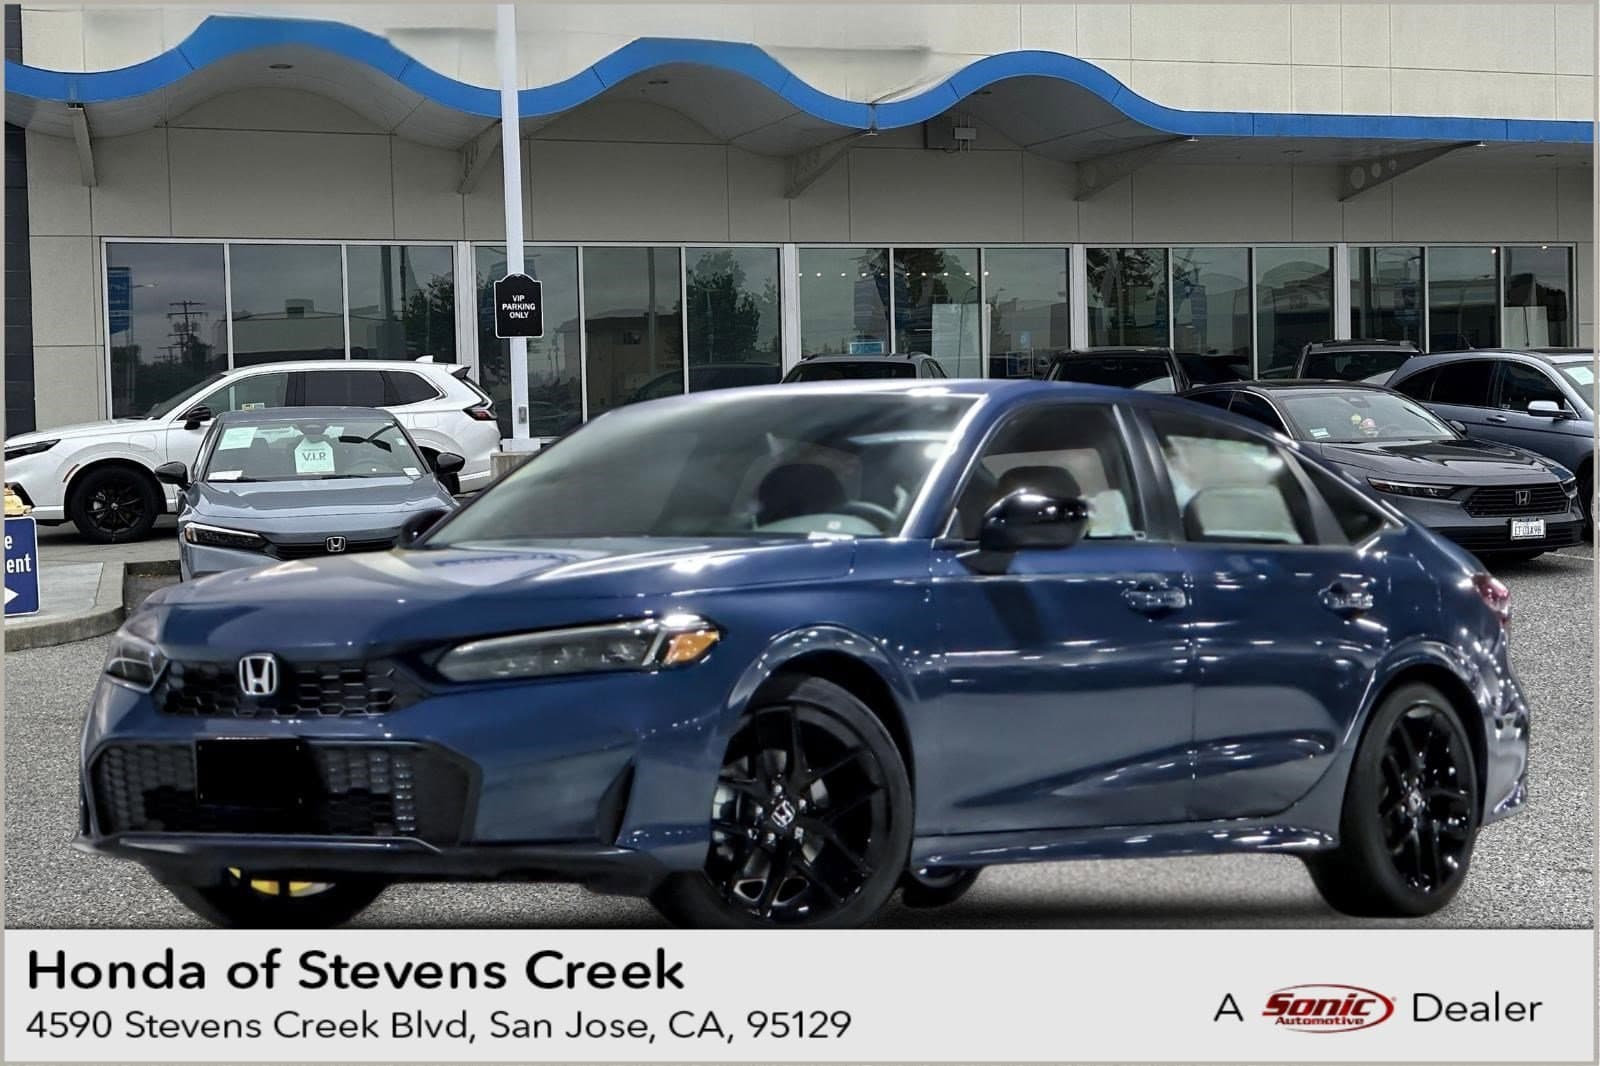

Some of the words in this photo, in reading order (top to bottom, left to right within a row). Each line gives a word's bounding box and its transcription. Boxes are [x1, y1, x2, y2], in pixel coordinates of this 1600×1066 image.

[512, 294, 525, 302] VIP
[502, 303, 536, 311] PARKING
[509, 311, 529, 319] ONLY
